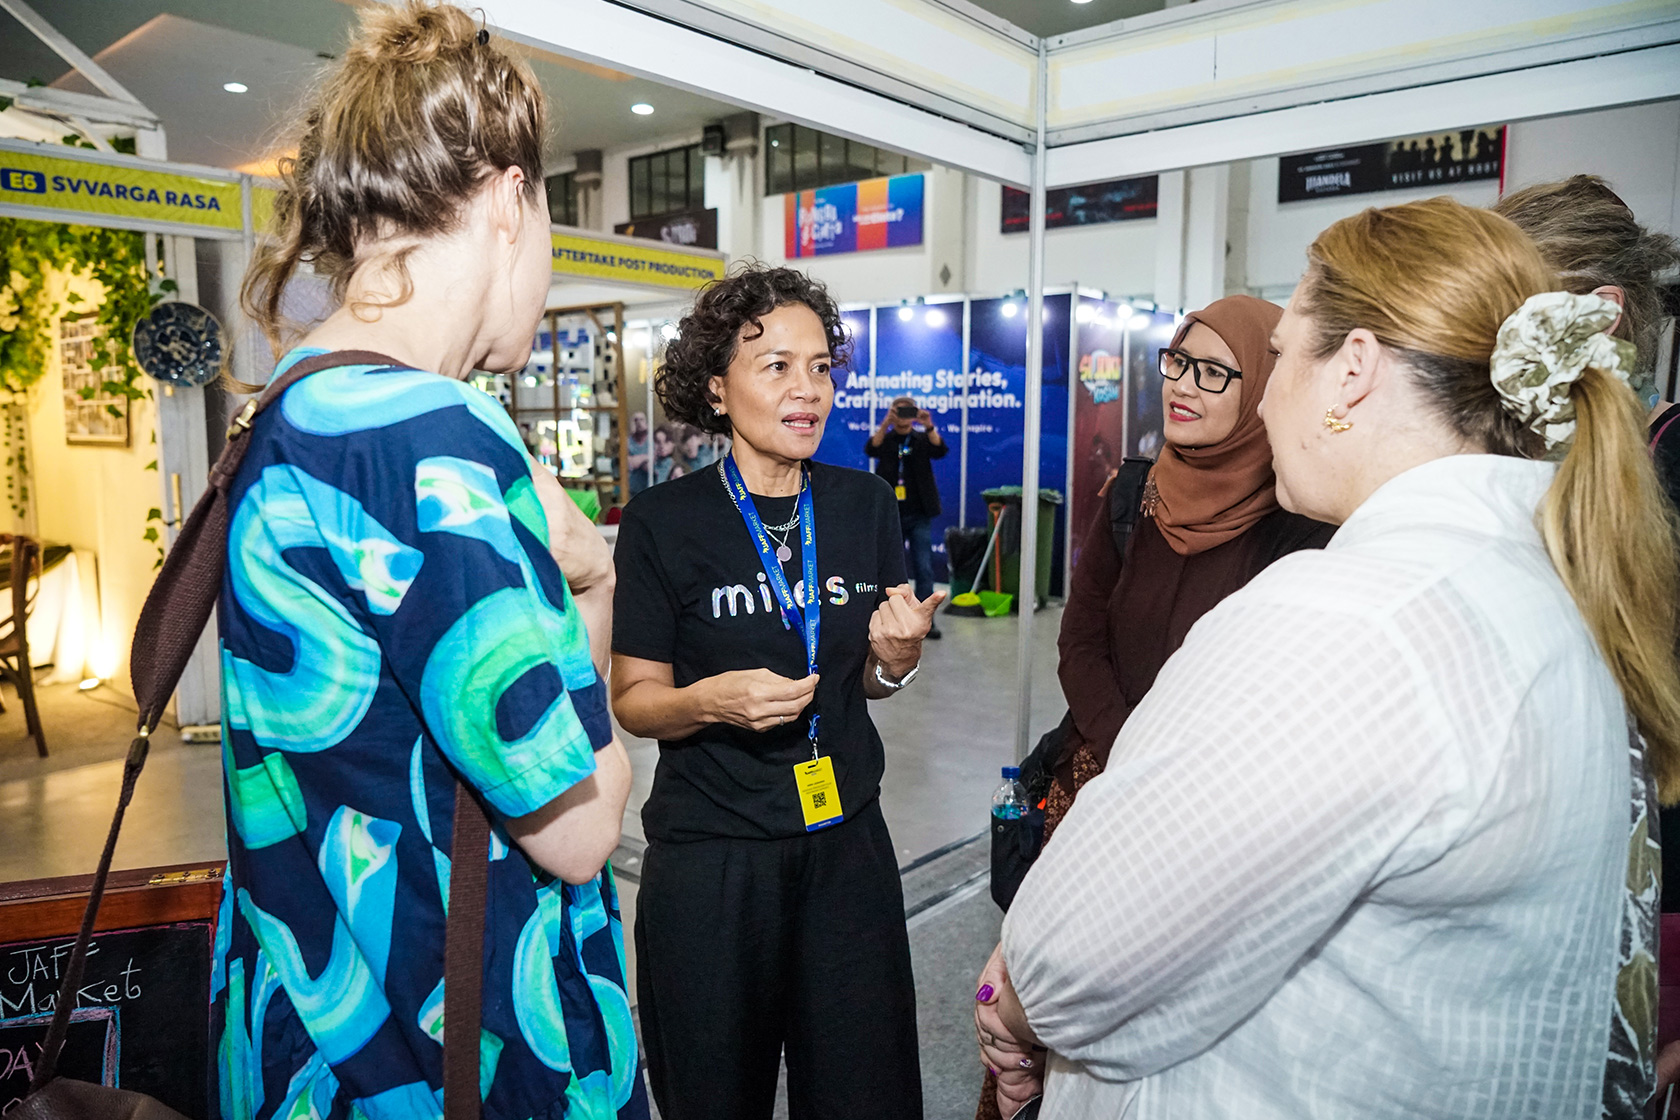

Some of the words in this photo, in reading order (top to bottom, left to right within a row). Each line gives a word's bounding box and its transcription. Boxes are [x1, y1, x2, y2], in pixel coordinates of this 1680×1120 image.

[9, 172, 37, 190] E6
[165, 191, 221, 211] RASA
[618, 257, 646, 271] POST
[649, 261, 714, 279] PRODUCTION
[845, 370, 933, 393] Animating
[935, 368, 1008, 389] Stories,
[834, 389, 894, 410] Crafin
[966, 424, 993, 434] nspire
